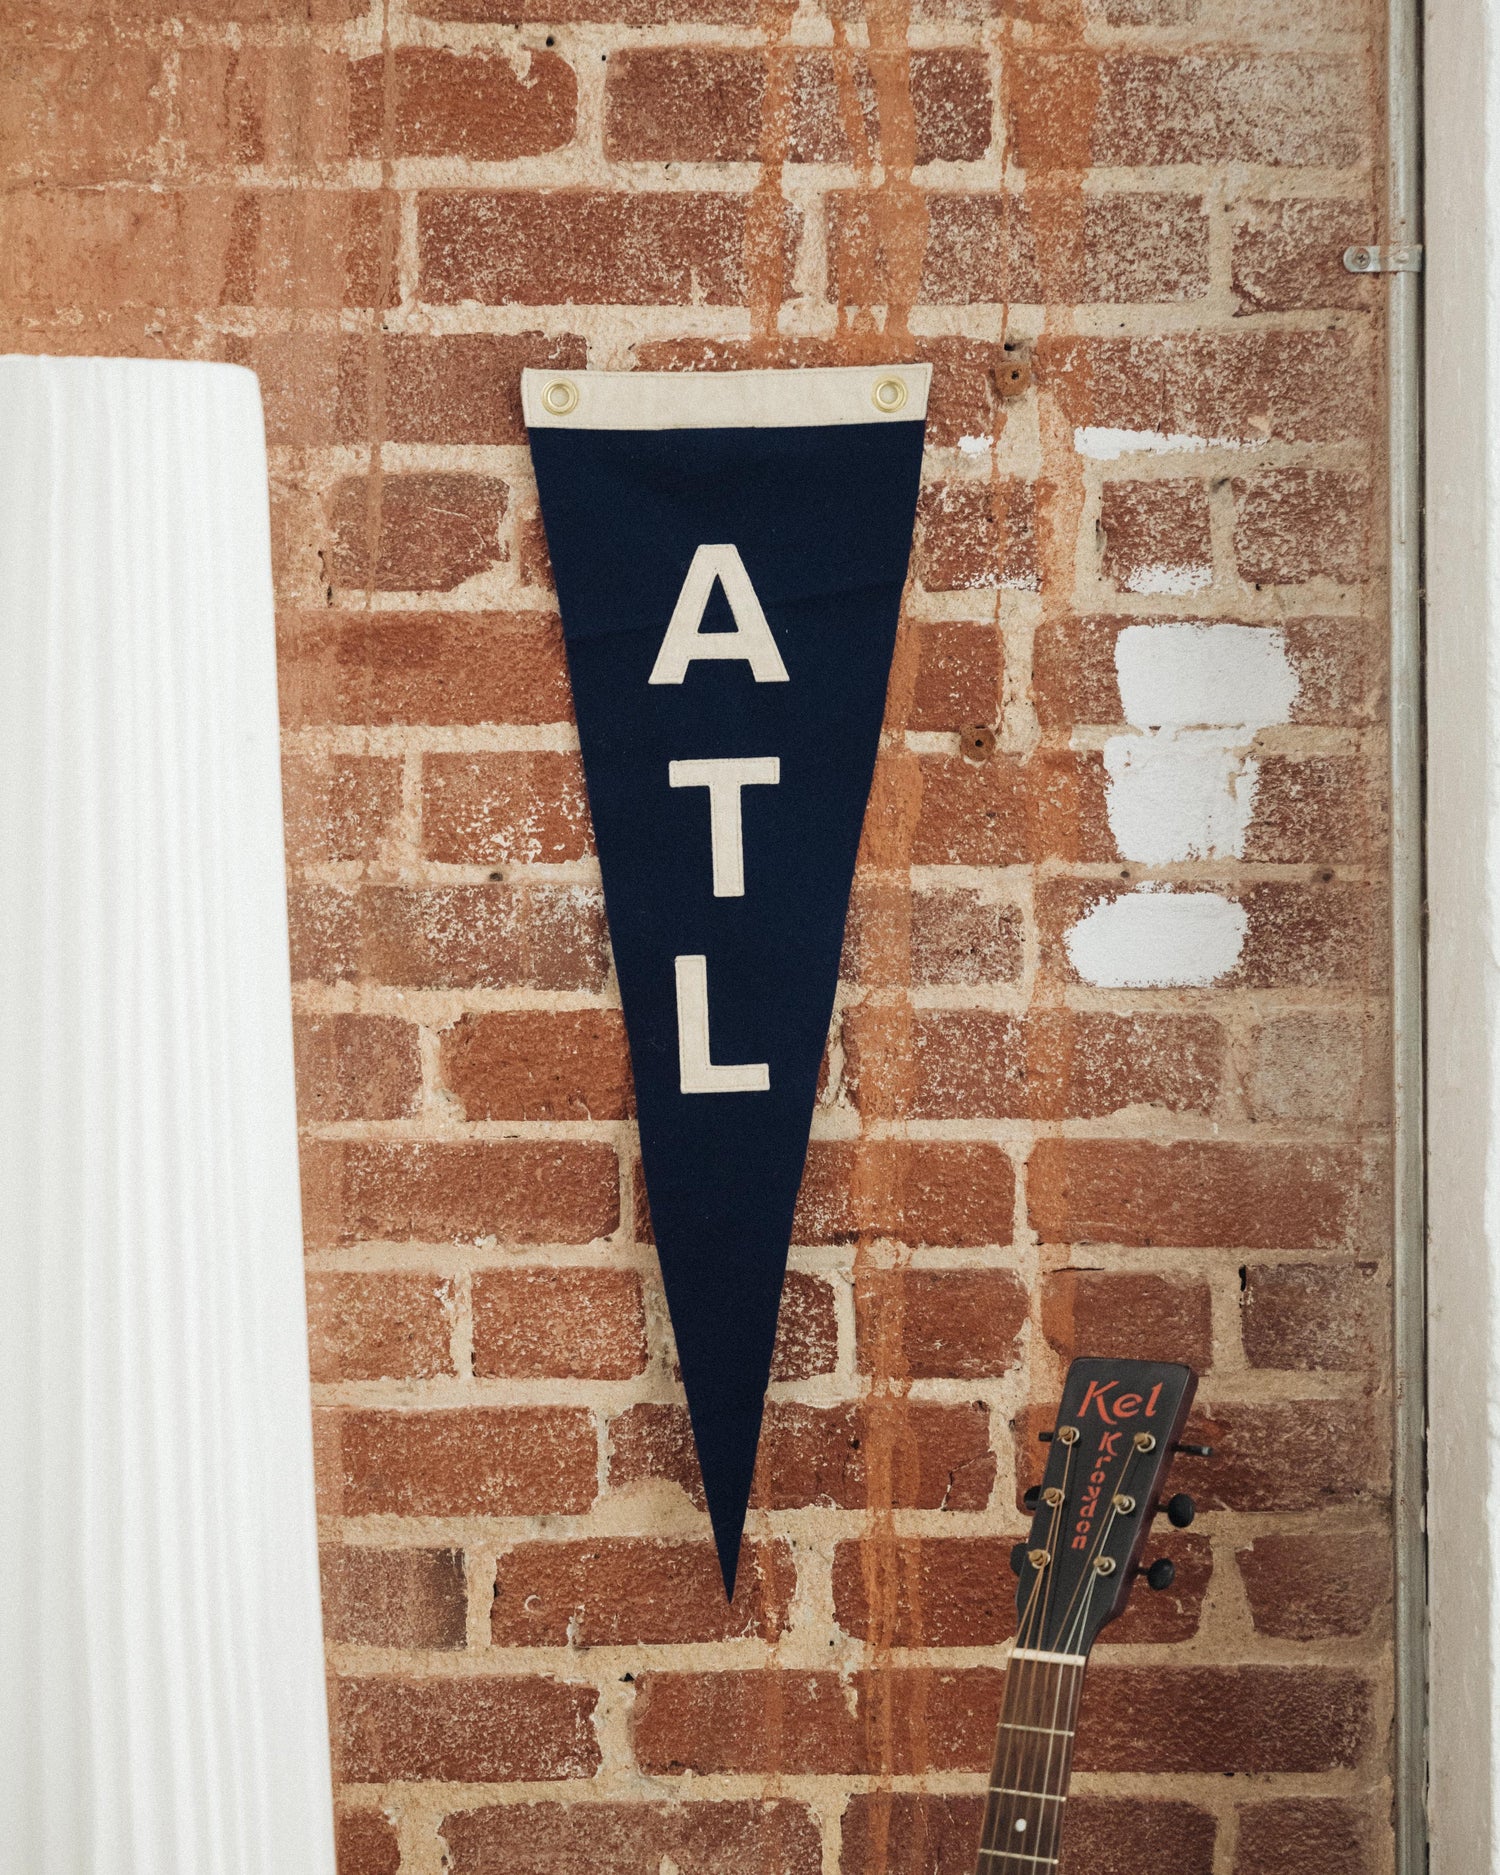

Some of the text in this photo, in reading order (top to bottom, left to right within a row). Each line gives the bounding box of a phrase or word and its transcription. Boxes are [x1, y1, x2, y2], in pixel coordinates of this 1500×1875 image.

[648, 543, 790, 1094] ATL
[1077, 1380, 1163, 1425] Kel
[1071, 1431, 1123, 1550] Kroydon
